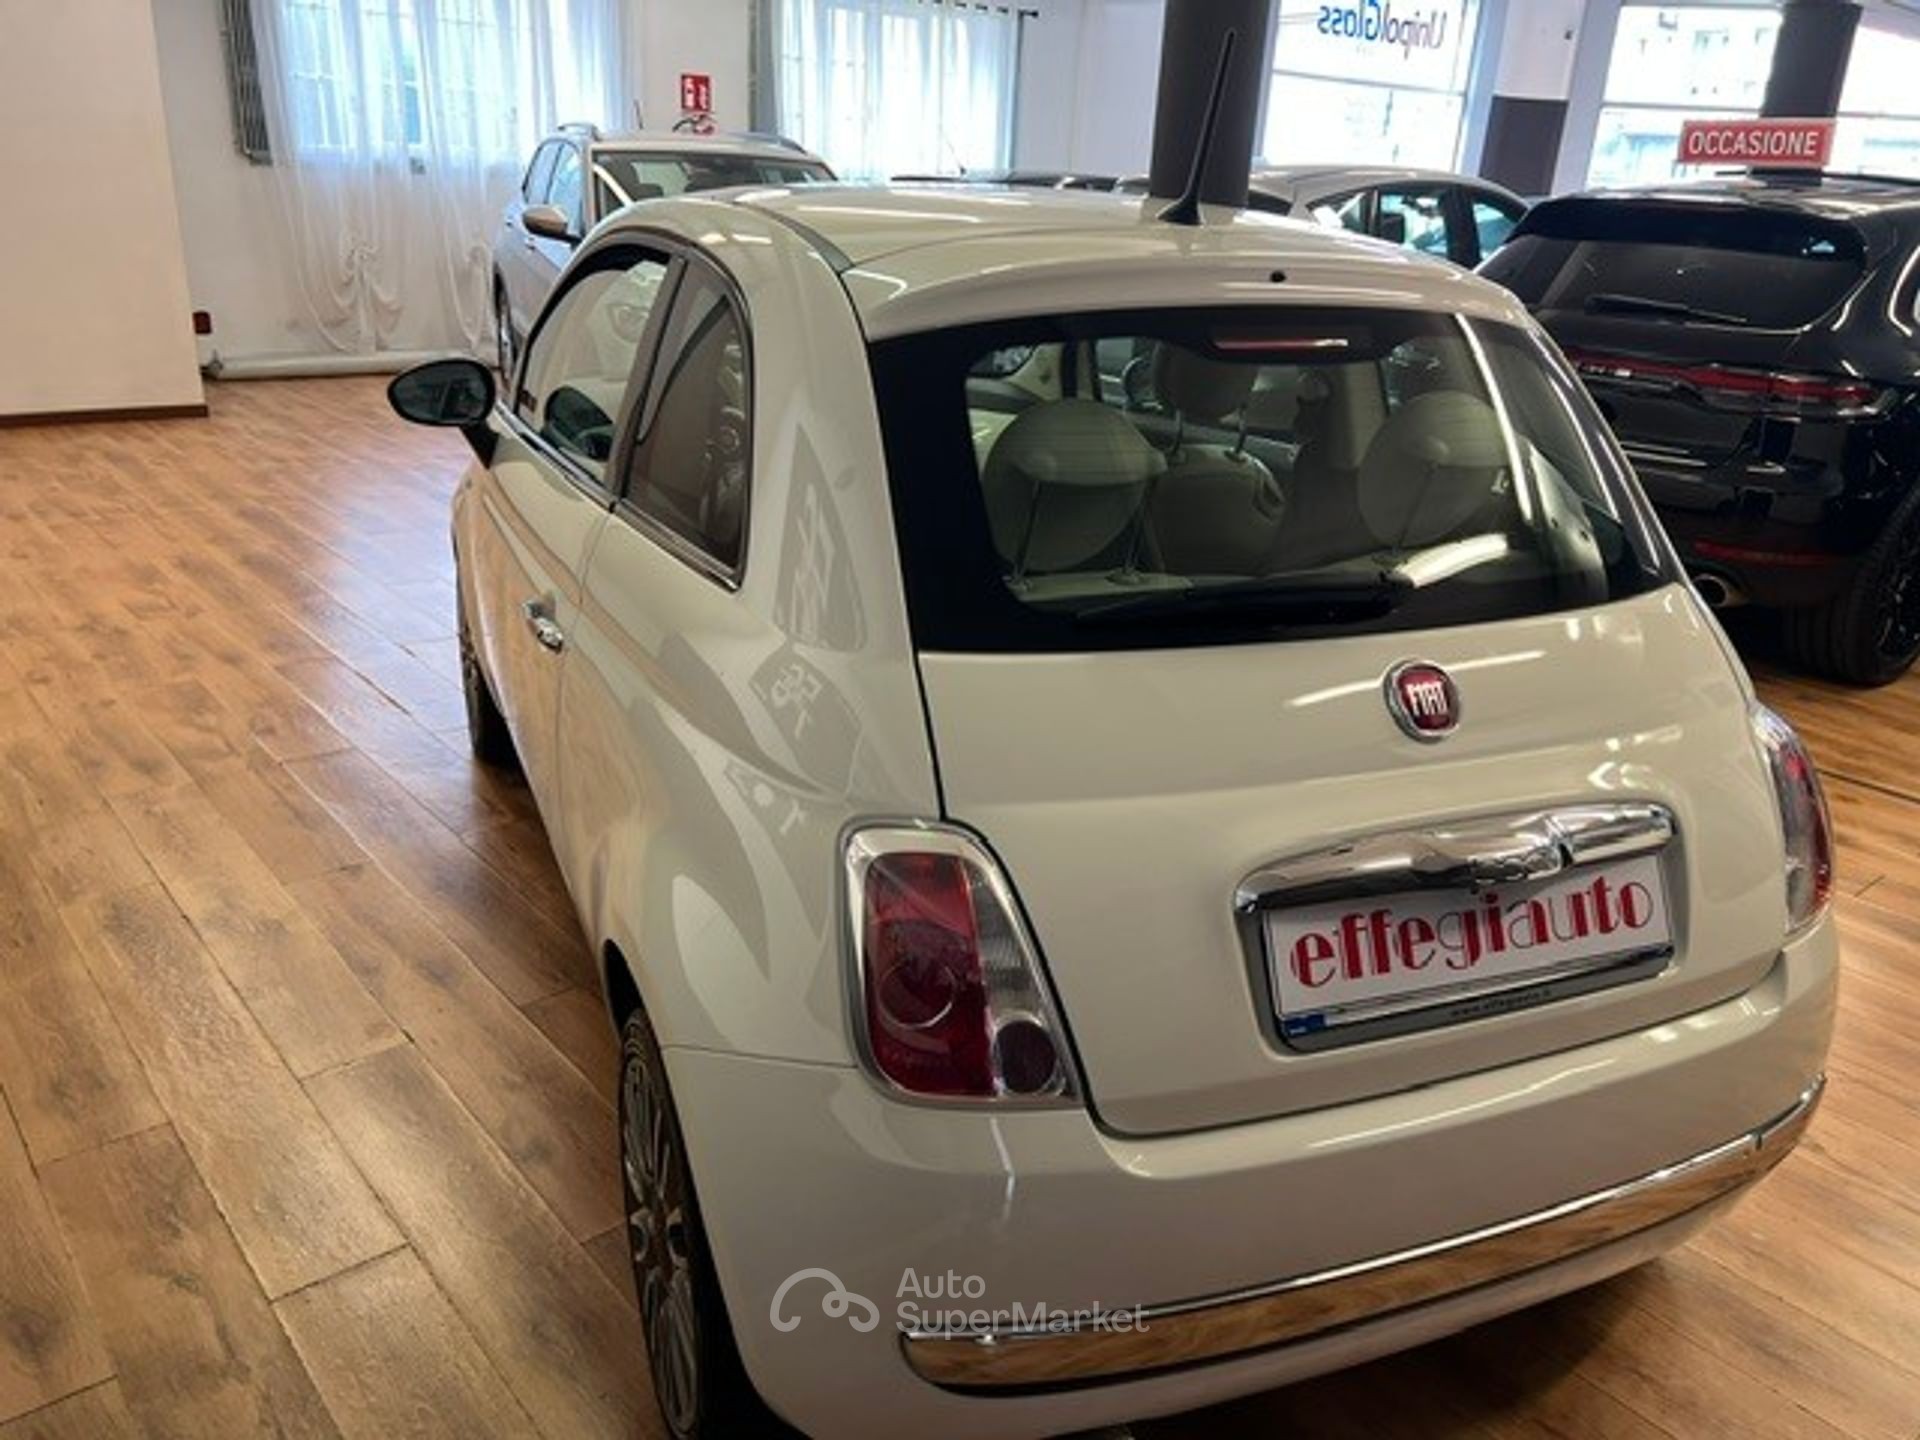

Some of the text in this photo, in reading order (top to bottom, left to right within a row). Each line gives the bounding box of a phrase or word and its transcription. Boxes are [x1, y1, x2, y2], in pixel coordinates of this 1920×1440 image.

[1688, 130, 1819, 156] OCCASIONE
[1405, 681, 1447, 717] FIAT
[1290, 876, 1653, 988] effegiauto
